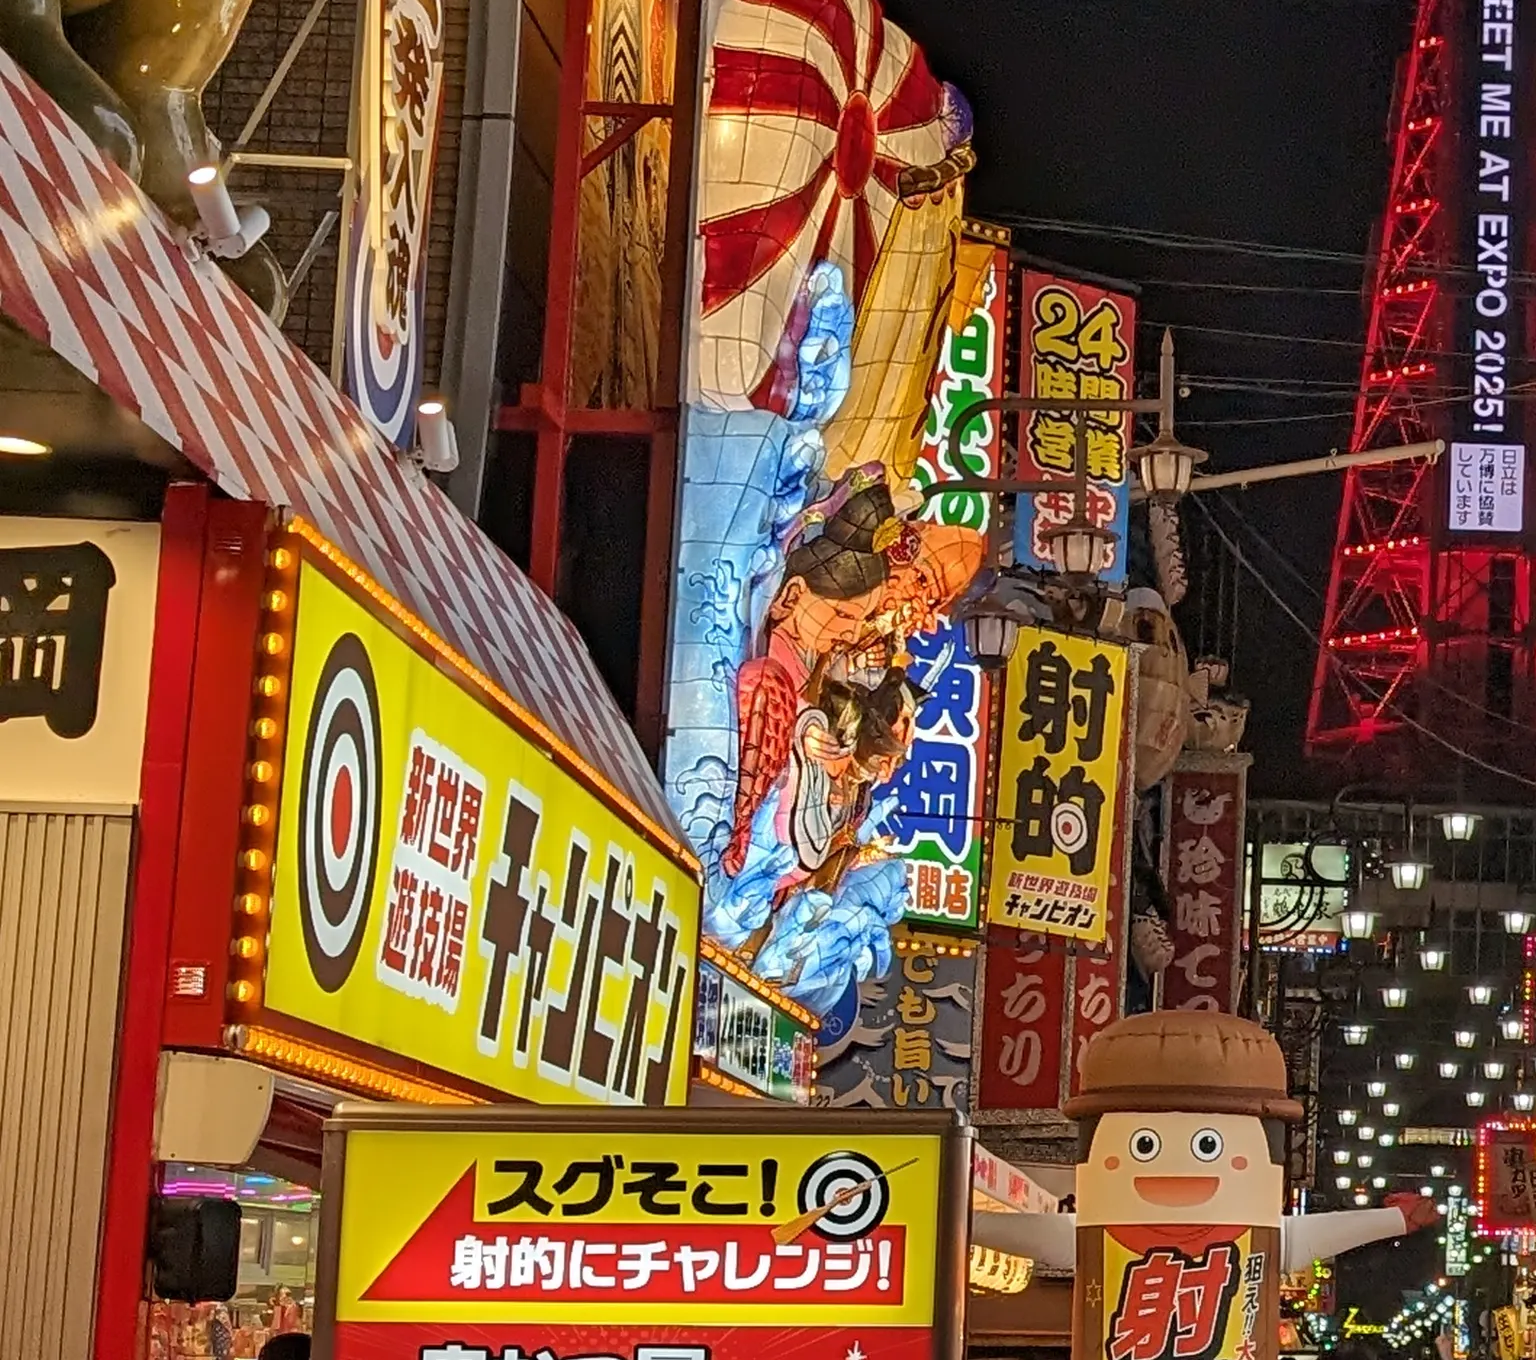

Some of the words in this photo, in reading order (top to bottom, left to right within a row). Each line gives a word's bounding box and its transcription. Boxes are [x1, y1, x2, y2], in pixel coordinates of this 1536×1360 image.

[1480, 84, 1512, 138] ME
[1479, 149, 1511, 202] AT
[1475, 215, 1510, 317] EXPO
[1034, 292, 1125, 369] 24
[1472, 332, 1508, 434] 2025!
[1456, 449, 1473, 525] しています
[1479, 449, 1495, 527] 万博に協賛
[1501, 449, 1518, 496] 日立は
[1012, 640, 1115, 877] 射的
[402, 745, 484, 882] 新世界
[381, 870, 468, 998] 遊技場
[481, 793, 686, 1106] チャンピオン
[1004, 894, 1098, 929] チャンピオン
[486, 1157, 776, 1217] スグそこ!
[449, 1235, 892, 1293] 射的にチャレンジ!
